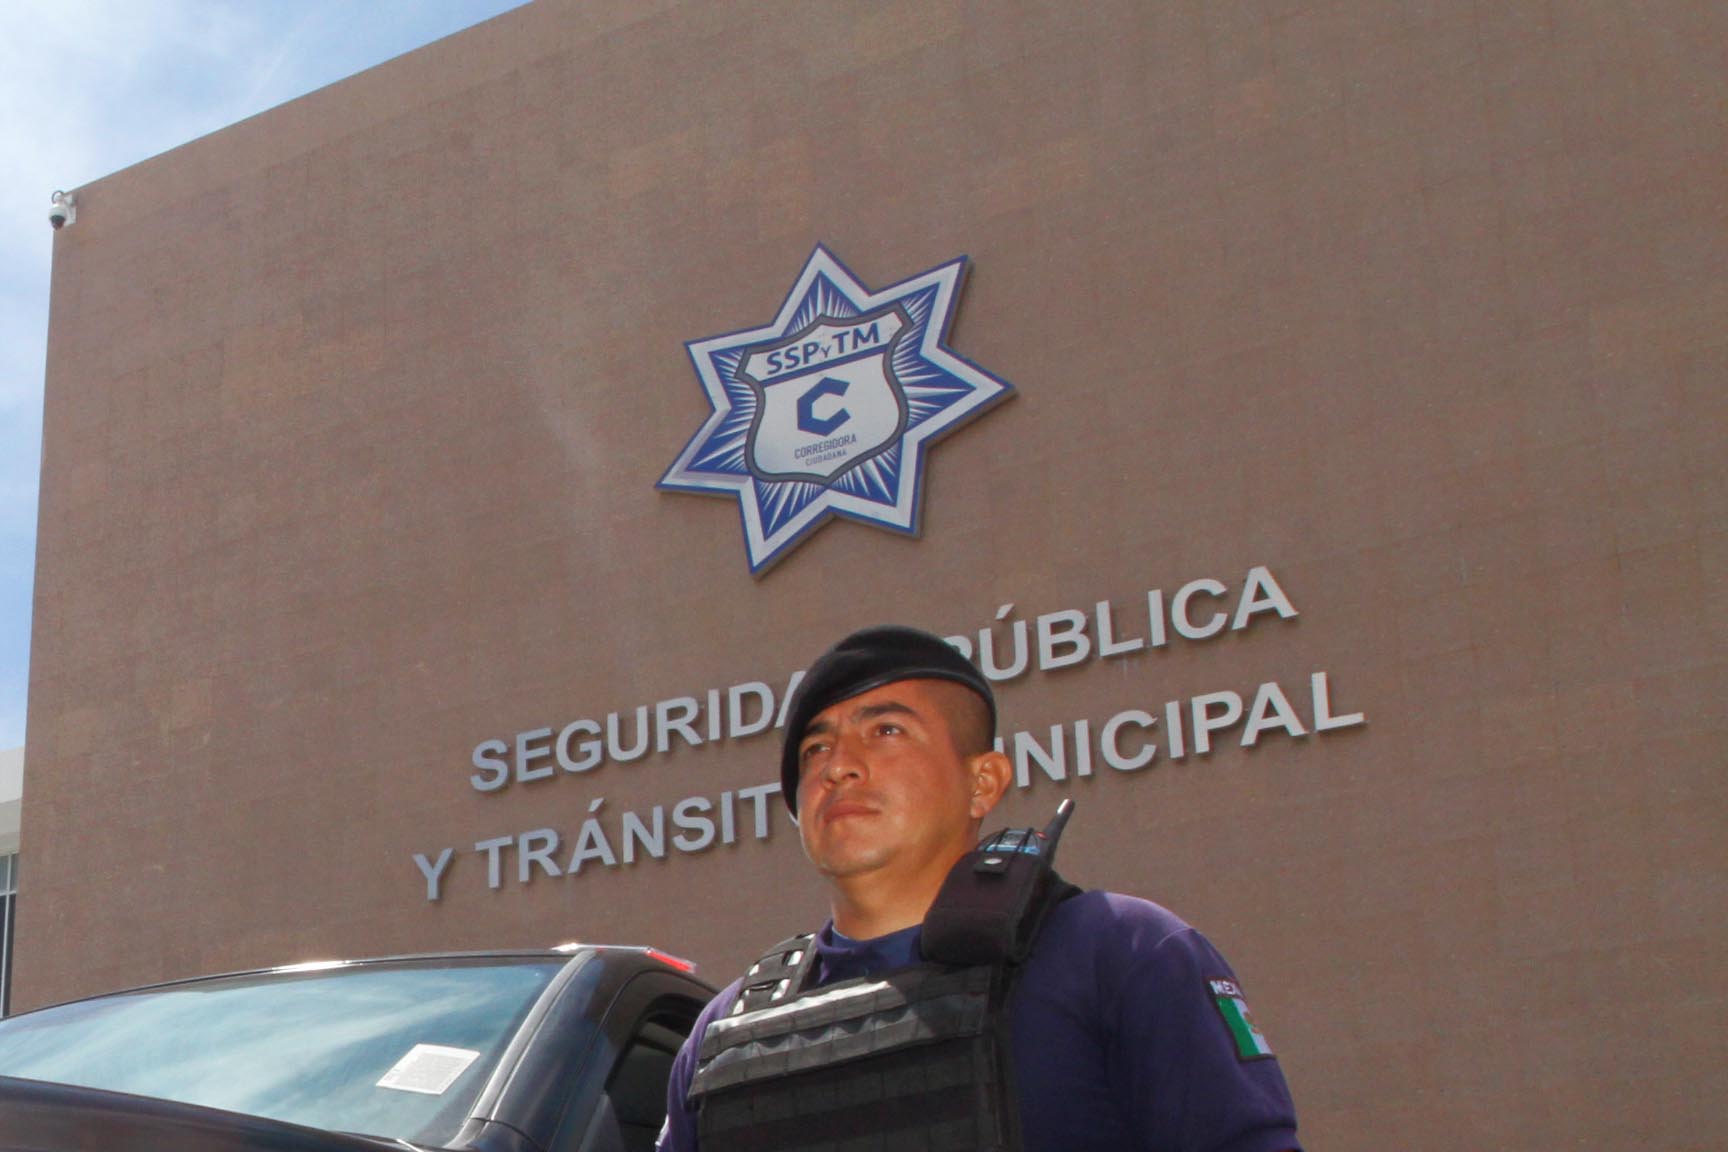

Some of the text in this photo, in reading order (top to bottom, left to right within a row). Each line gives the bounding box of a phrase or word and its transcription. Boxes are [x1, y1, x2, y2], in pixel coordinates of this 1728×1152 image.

[794, 433, 857, 460] CORREGIDORA
[796, 376, 851, 437] C
[471, 565, 1299, 793] SEGURID ÚBLICA
[412, 670, 1367, 902] Y TRÁNSIT NICIPAL
